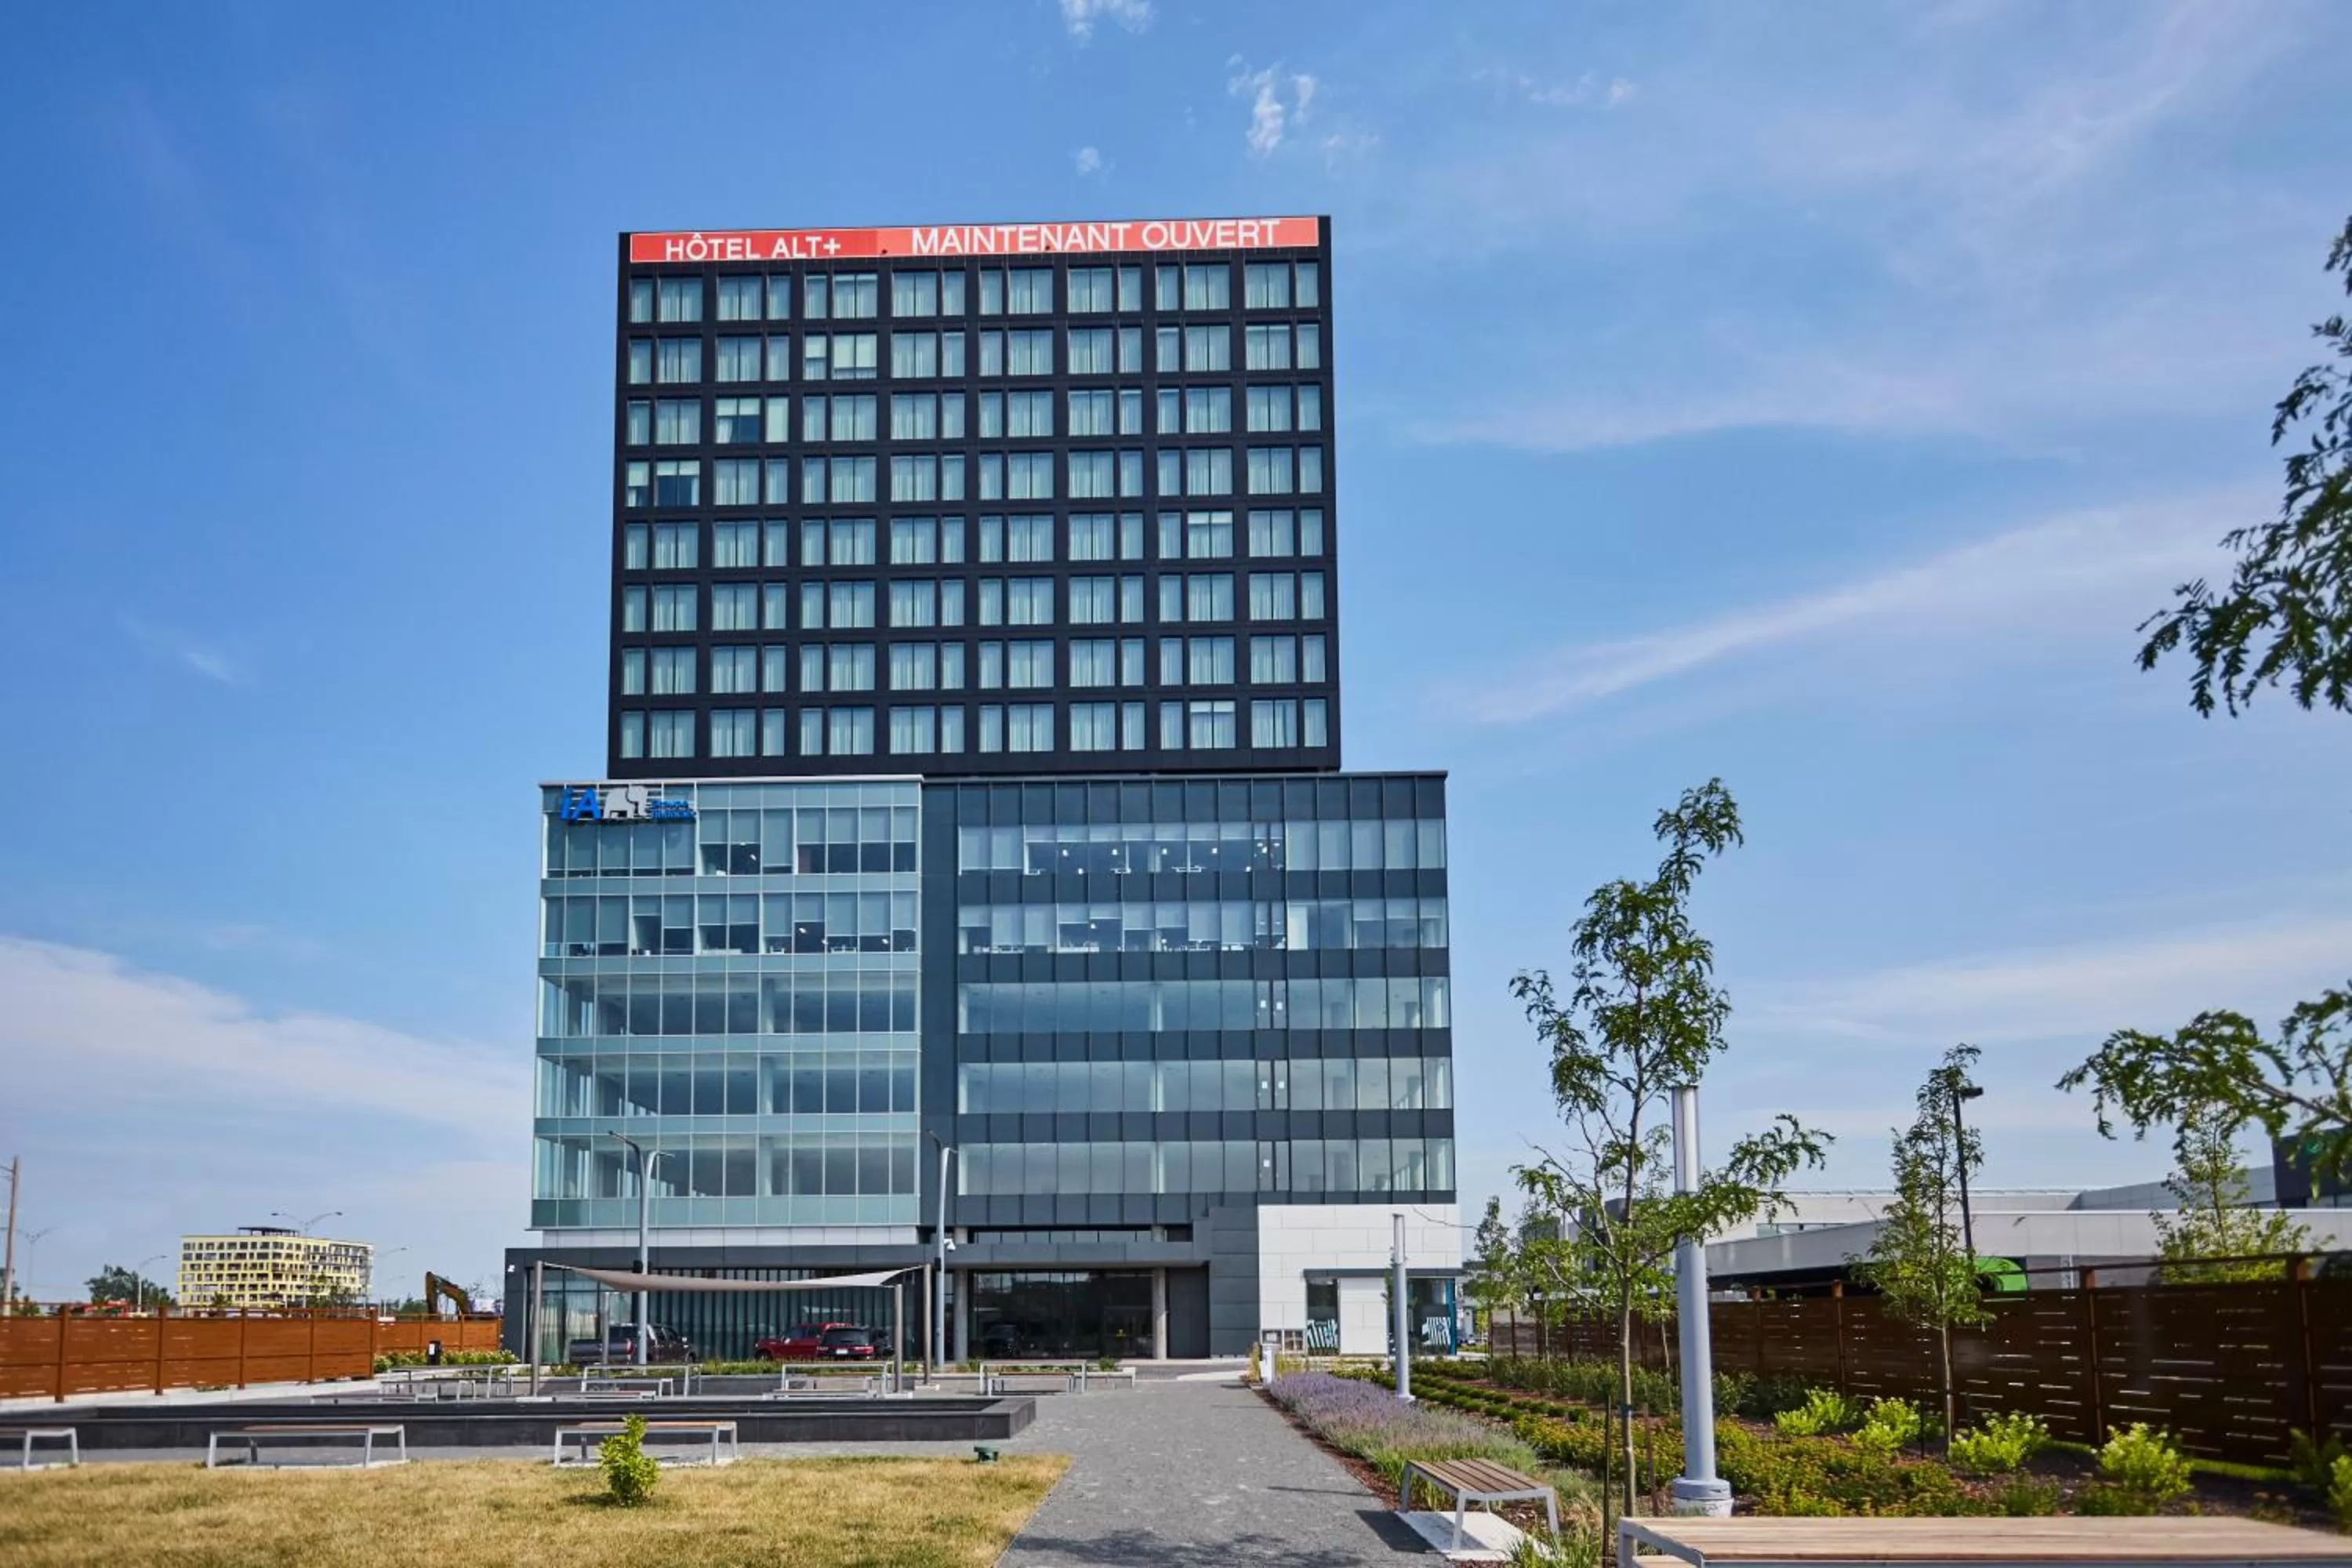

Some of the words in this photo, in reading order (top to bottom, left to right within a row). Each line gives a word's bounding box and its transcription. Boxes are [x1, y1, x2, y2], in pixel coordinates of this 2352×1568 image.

[666, 232, 760, 260] HÔTEL
[771, 236, 841, 259] ALT+
[912, 223, 1132, 255] MAINTENANT
[1142, 220, 1280, 249] OUVERT
